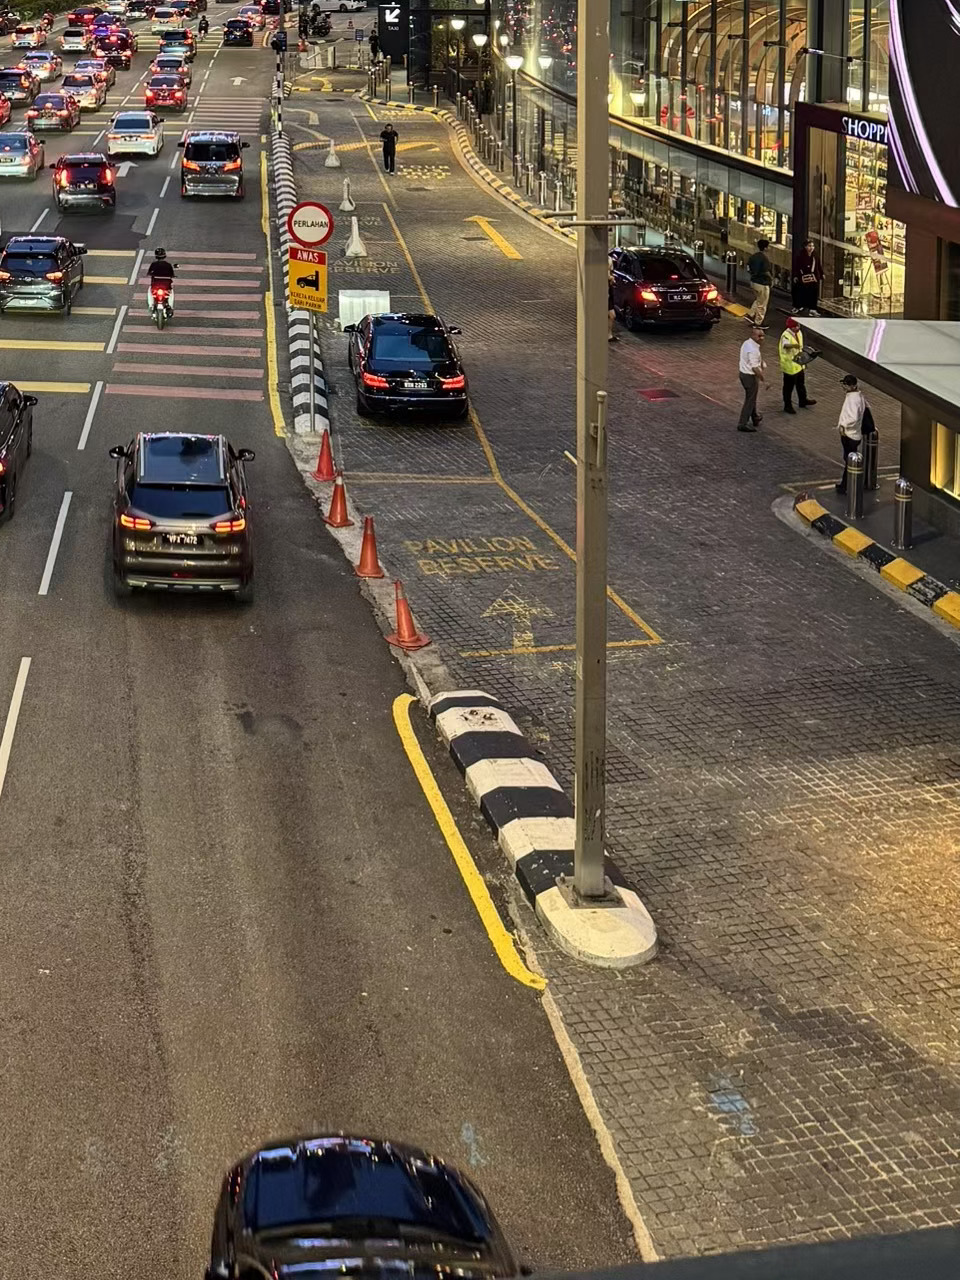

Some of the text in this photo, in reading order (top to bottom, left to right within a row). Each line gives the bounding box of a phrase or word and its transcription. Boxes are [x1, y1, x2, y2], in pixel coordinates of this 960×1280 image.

[293, 220, 329, 228] PERLAHAN
[297, 250, 319, 263] AWAS
[402, 535, 537, 554] PAVILION
[417, 553, 560, 575] RESERVE
